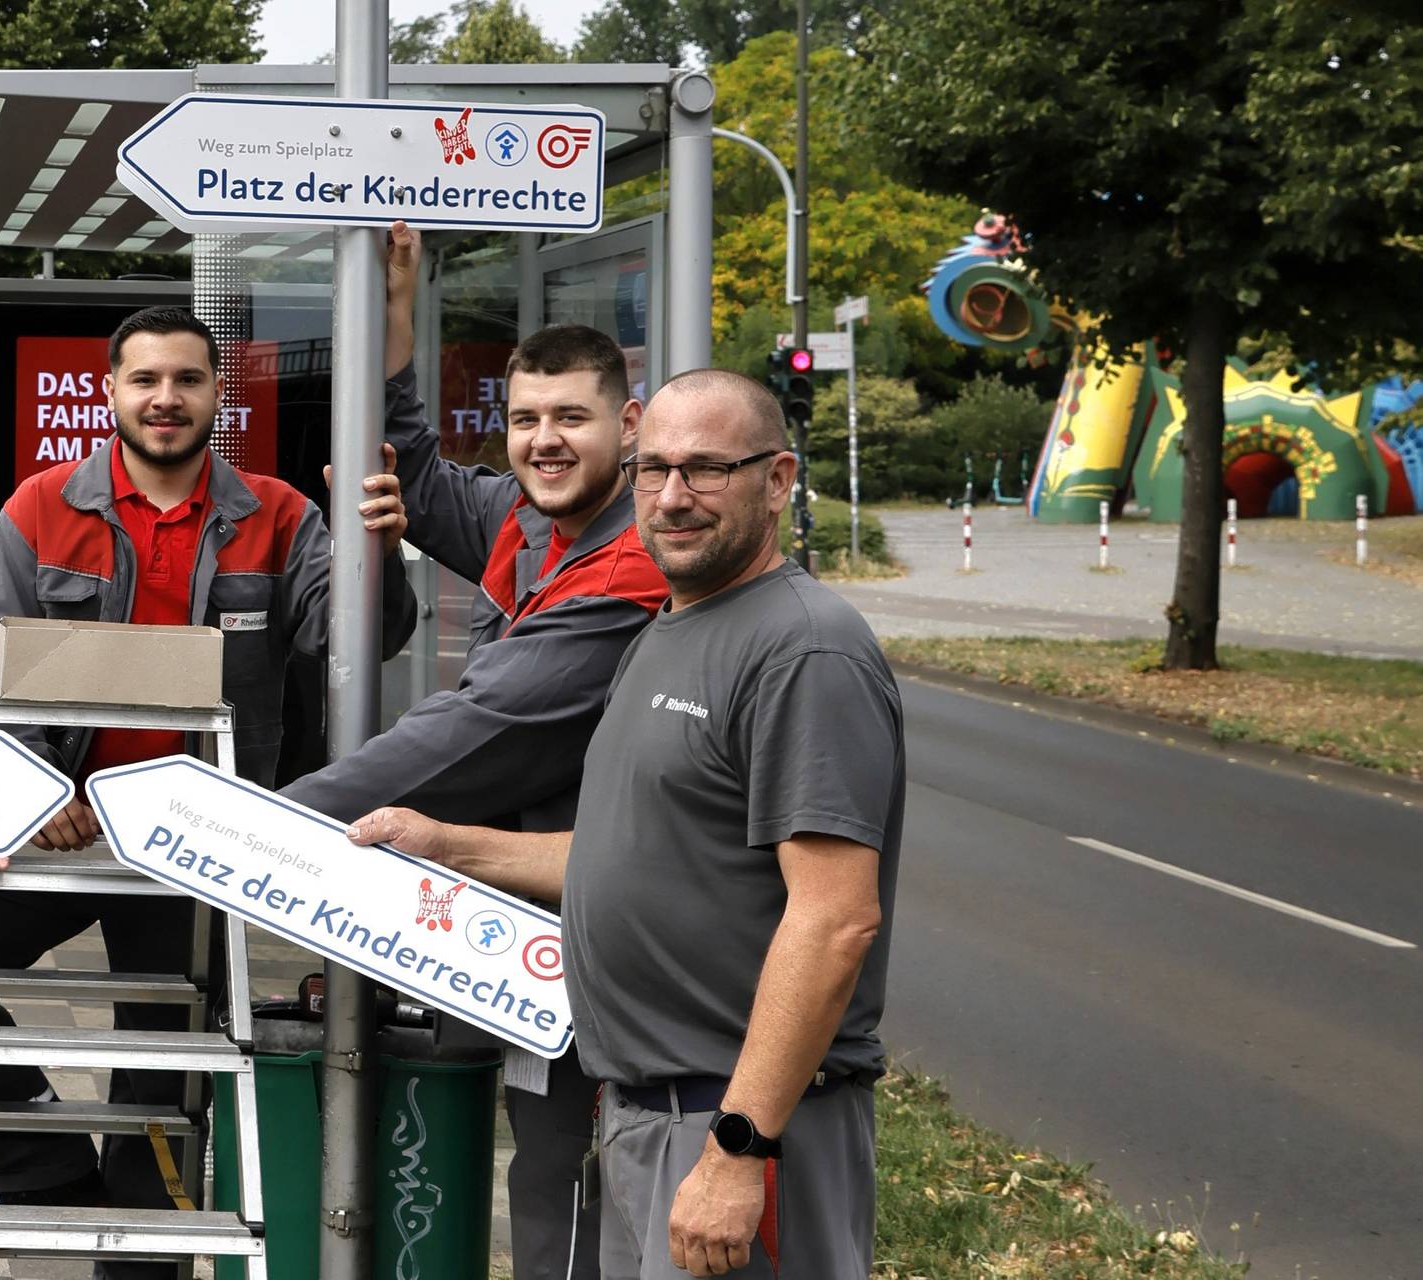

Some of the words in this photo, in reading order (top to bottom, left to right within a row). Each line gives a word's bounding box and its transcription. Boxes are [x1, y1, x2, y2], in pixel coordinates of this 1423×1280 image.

[198, 138, 235, 158] Weg
[238, 143, 271, 155] zum
[275, 140, 353, 160] Spielplatz
[197, 168, 284, 201] Platz
[295, 171, 353, 204] der
[363, 174, 586, 212] Kinderrechte
[37, 372, 94, 397] DAS
[35, 436, 82, 461] AM
[169, 798, 204, 829] Weg
[206, 819, 241, 842] zum
[243, 833, 324, 879] Spielplatz
[144, 825, 236, 888] Platz
[242, 873, 307, 916] der
[310, 899, 558, 1032] Kinderrechte
